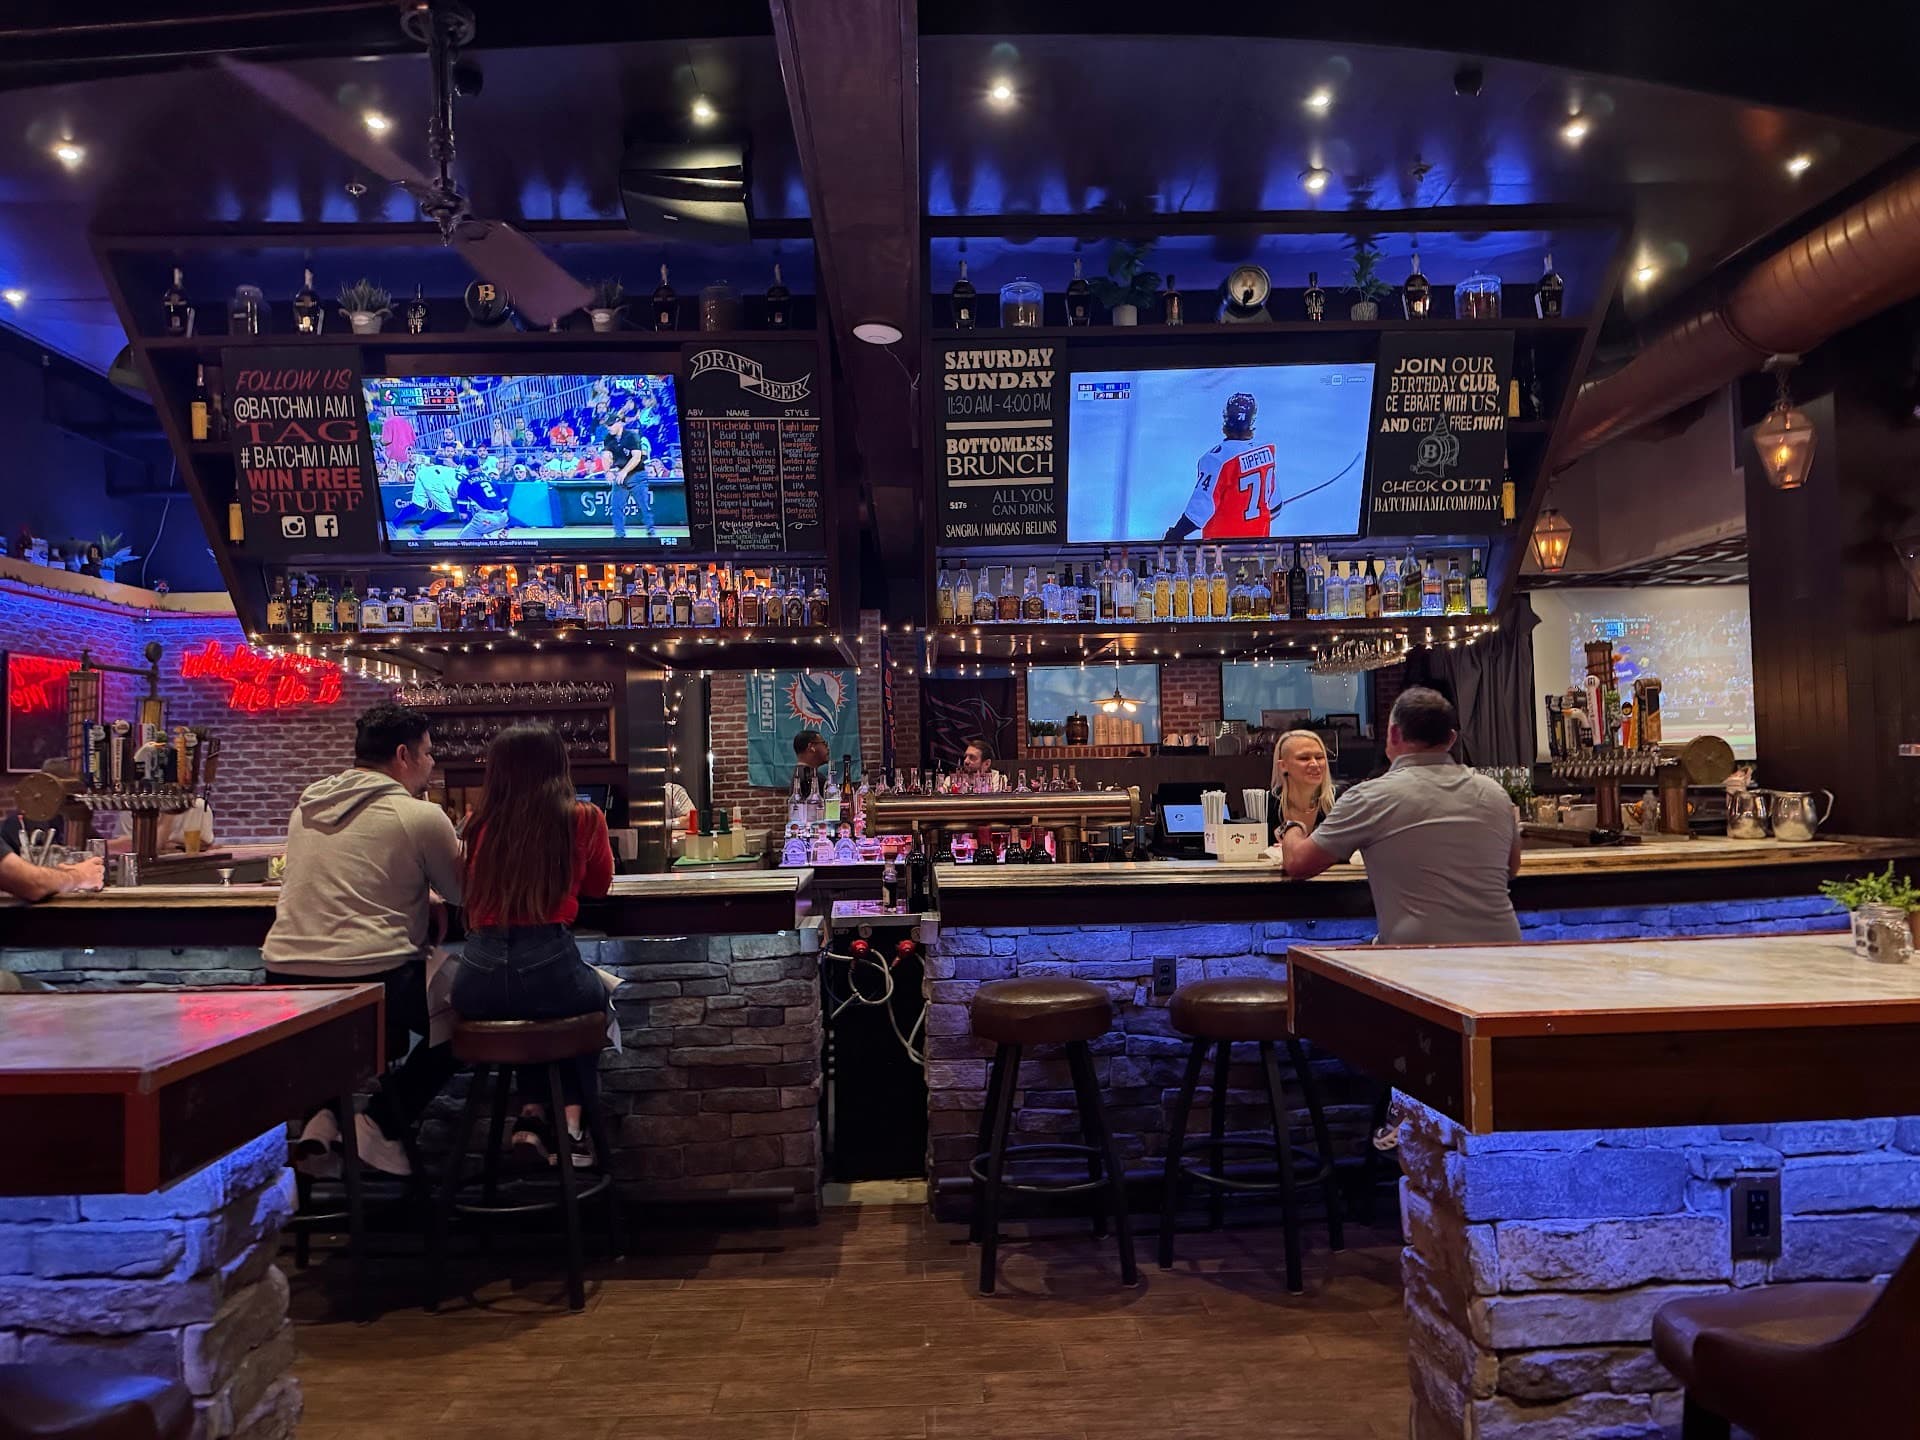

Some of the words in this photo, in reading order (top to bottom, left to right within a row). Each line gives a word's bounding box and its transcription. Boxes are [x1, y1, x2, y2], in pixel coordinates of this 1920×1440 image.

[478, 284, 496, 302] B
[699, 352, 761, 378] DRAFT
[944, 347, 1054, 370] SATURDAY
[1394, 358, 1446, 374] JOIN
[1451, 357, 1495, 373] OUR
[236, 368, 319, 391] FOLLOW
[322, 368, 353, 390] US
[615, 380, 634, 389] FOX
[944, 370, 1055, 391] SUNDAY
[1390, 375, 1457, 393] BIRTHDAY
[1460, 373, 1500, 396] CLUB,
[760, 382, 802, 400] BEER
[726, 409, 750, 417] NAME
[784, 409, 810, 417] STYLE
[947, 395, 973, 416] 11:30
[975, 394, 993, 414] AM
[1002, 393, 1031, 413] 4:00
[1034, 392, 1051, 411] PM
[1444, 394, 1467, 412] WITH
[1470, 394, 1501, 414] US,
[236, 420, 360, 445] TAG
[1380, 417, 1409, 433] AND
[1412, 417, 1435, 432] GET
[1449, 416, 1472, 431] FREE
[714, 440, 736, 449] Stella
[720, 431, 736, 440] Bud
[946, 435, 1053, 454] BOTTOMLESS
[1423, 444, 1437, 459] B
[947, 453, 1053, 476] BRUNCH
[246, 468, 294, 491] WIN
[301, 467, 362, 490] FREE
[1382, 479, 1439, 493] CHECK
[1441, 478, 1492, 492] OUT
[480, 481, 497, 498] 2
[992, 489, 1019, 504] ALL
[1021, 487, 1054, 503] YOU
[251, 489, 364, 515] STUFF
[992, 504, 1017, 517] CAN
[1020, 502, 1055, 515] DRINK
[1374, 495, 1500, 513] BATCHMIAMI.COM/BDAY
[946, 522, 979, 538] SANGRIA
[984, 521, 1020, 537] MIMOSAS
[1026, 520, 1057, 535] BELLINIS
[660, 537, 678, 546] FS2
[274, 676, 309, 708] Do
[313, 673, 341, 704] It
[760, 683, 773, 729] LIGHT
